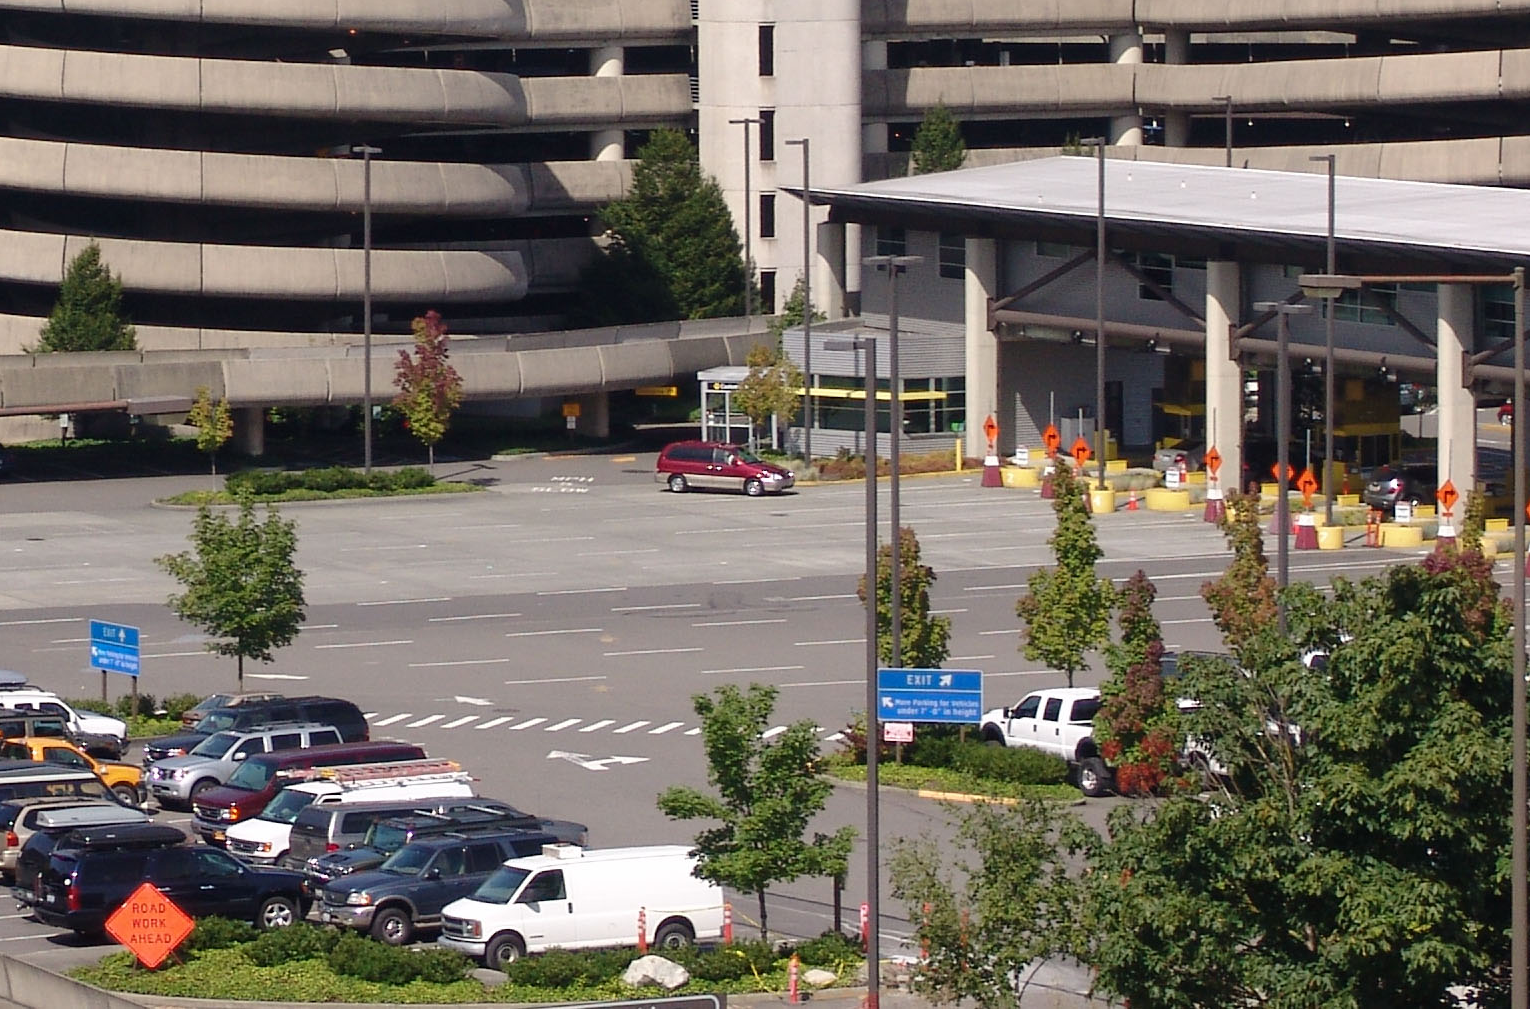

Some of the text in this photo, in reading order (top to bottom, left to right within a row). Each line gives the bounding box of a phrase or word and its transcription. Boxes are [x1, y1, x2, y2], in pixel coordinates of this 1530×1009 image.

[103, 627, 116, 637] EXIT
[906, 674, 932, 686] EXIT
[132, 903, 166, 913] ROAD
[132, 919, 166, 929] WORK
[130, 934, 172, 944] AHEAD
